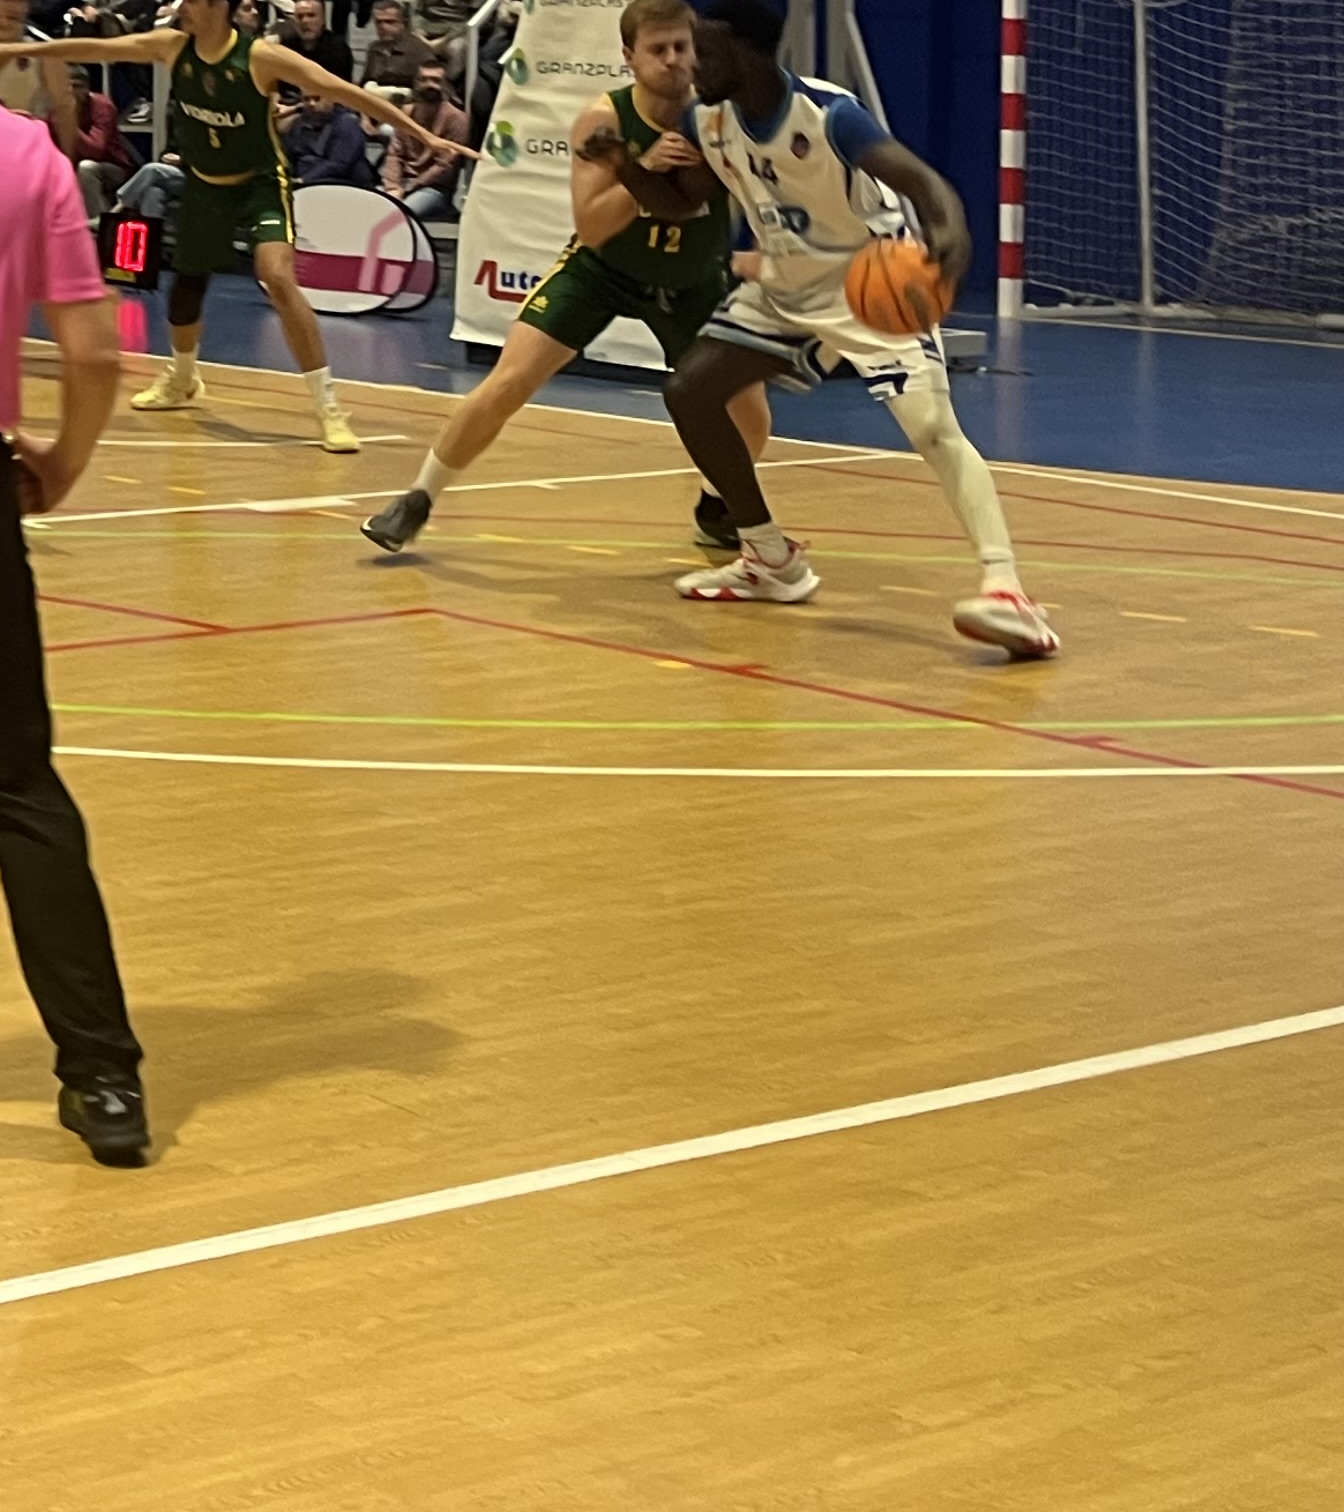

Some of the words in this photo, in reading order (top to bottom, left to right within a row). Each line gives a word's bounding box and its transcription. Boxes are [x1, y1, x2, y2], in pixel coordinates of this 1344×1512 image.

[535, 60, 634, 78] GRANZPLA
[114, 221, 148, 272] 10
[648, 225, 682, 253] 12
